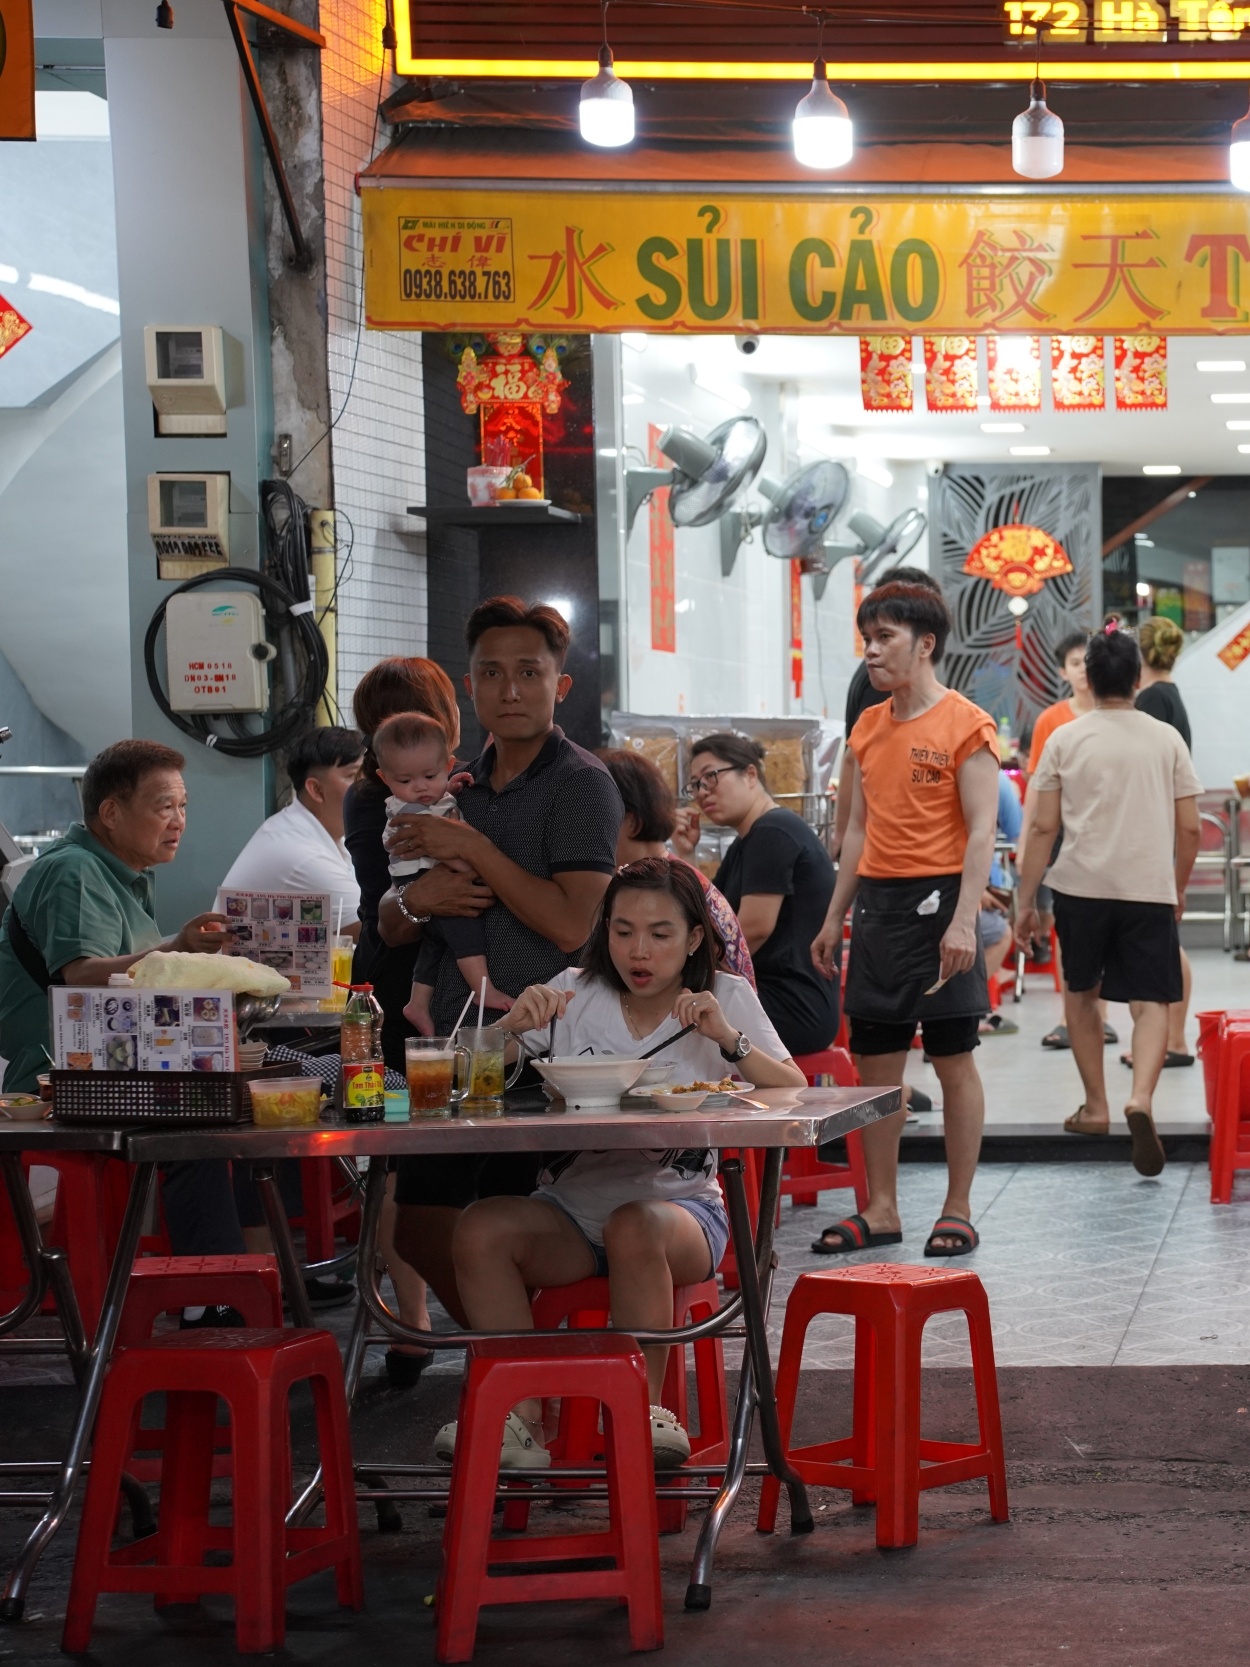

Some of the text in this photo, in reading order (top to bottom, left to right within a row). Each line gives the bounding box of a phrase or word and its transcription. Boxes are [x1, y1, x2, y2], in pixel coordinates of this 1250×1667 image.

[1004, 0, 1083, 35] 172
[1102, 0, 1161, 34] Hà
[403, 231, 509, 254] CHÍ VĨ
[527, 225, 625, 319] 水
[635, 204, 765, 321] SỦI
[788, 205, 946, 322] CẢO
[1071, 228, 1170, 323] 天
[403, 268, 512, 300] 0938.638.763
[490, 363, 527, 399] 福
